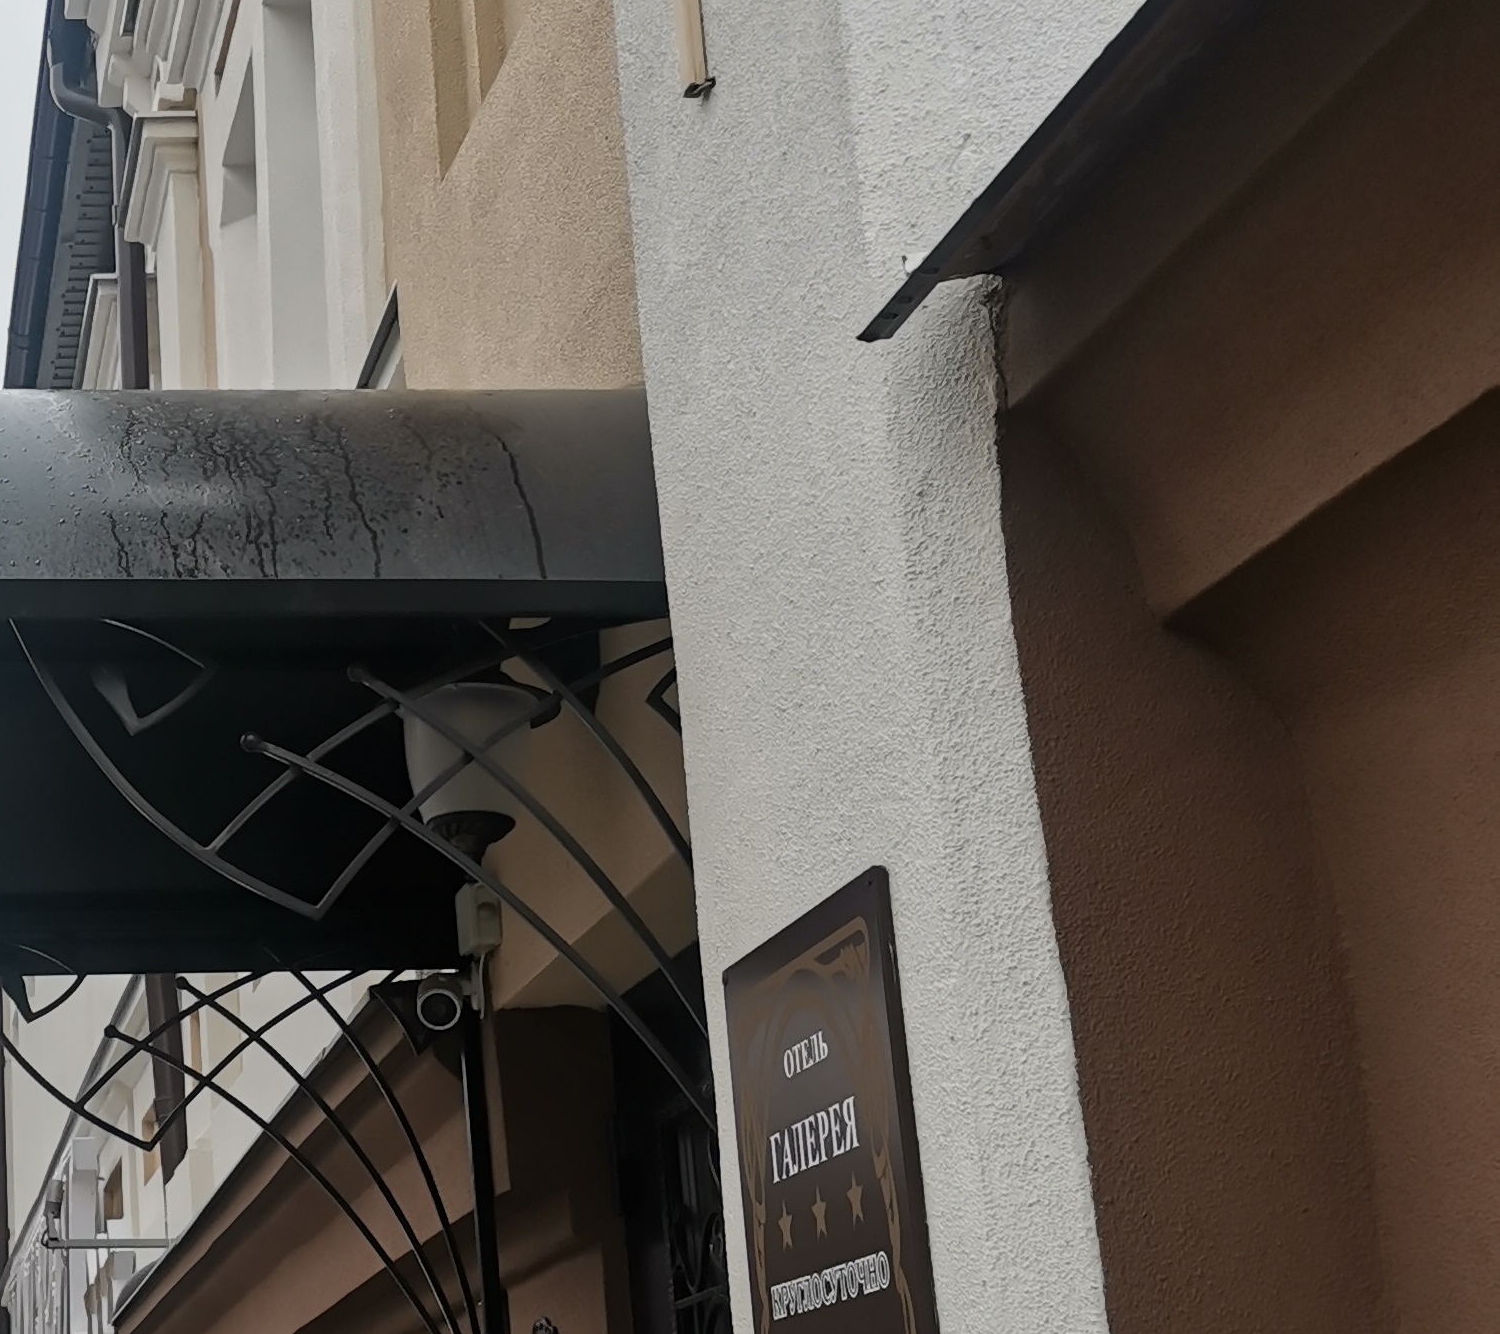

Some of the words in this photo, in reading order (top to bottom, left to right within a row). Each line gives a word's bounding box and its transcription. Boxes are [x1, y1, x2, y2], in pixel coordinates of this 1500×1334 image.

[783, 1029, 829, 1079] ОТЕЛЬ
[769, 1095, 860, 1185] ГАЛЕРЕЯ
[770, 1250, 891, 1321] КРУГЛОСУТОЧНО
